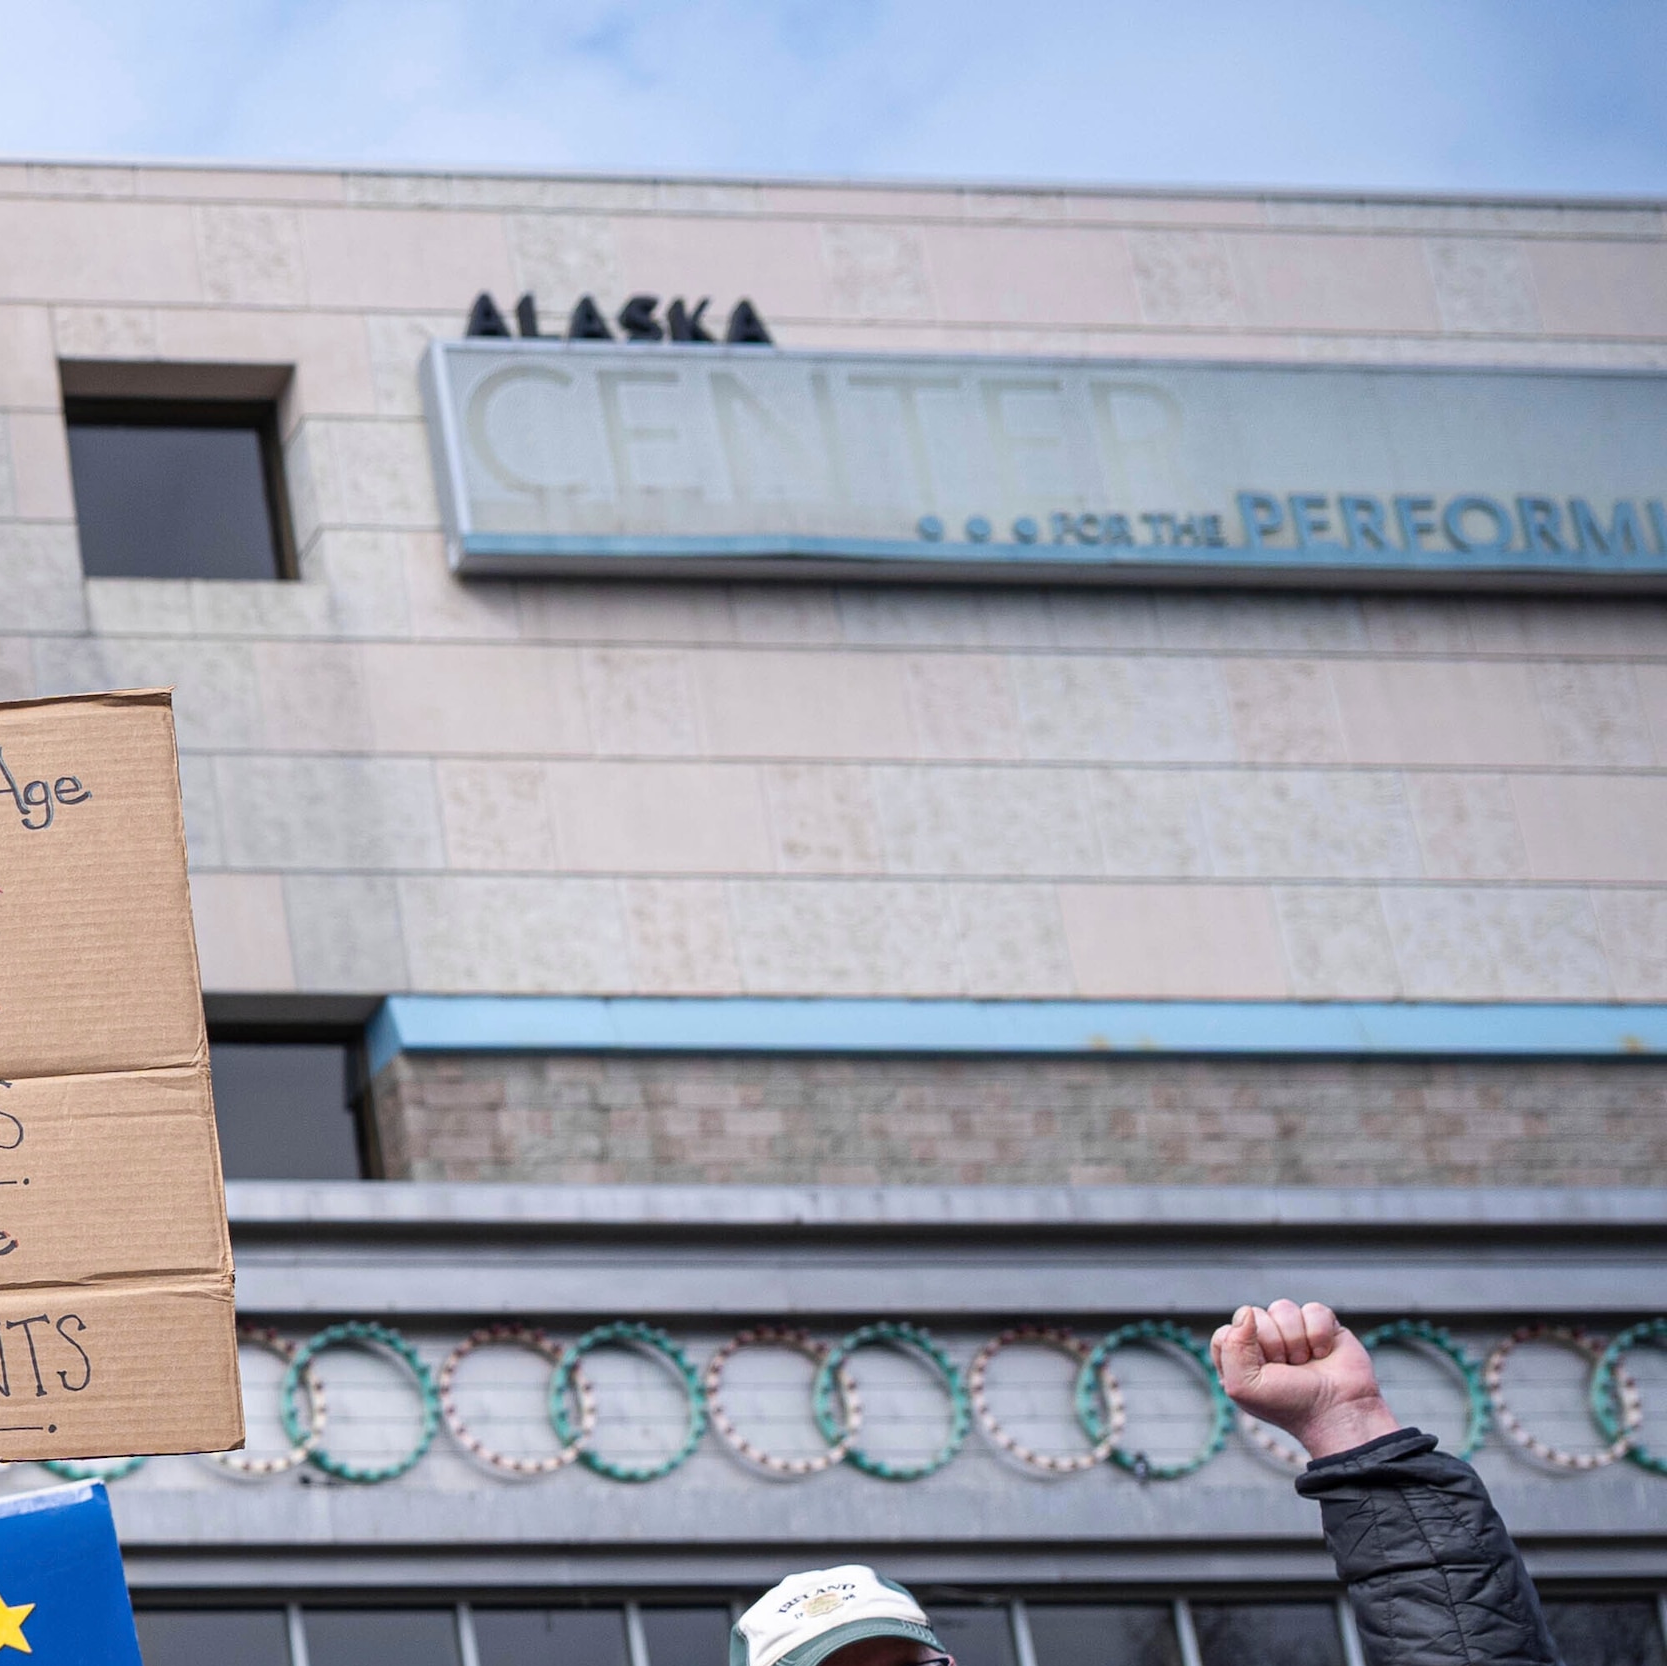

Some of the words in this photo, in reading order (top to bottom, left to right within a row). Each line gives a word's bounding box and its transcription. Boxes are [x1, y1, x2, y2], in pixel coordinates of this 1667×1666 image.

[464, 292, 774, 345] ALASKA
[467, 363, 1189, 508] CENTER
[1049, 511, 1134, 547] FOR
[1140, 512, 1227, 548] THE
